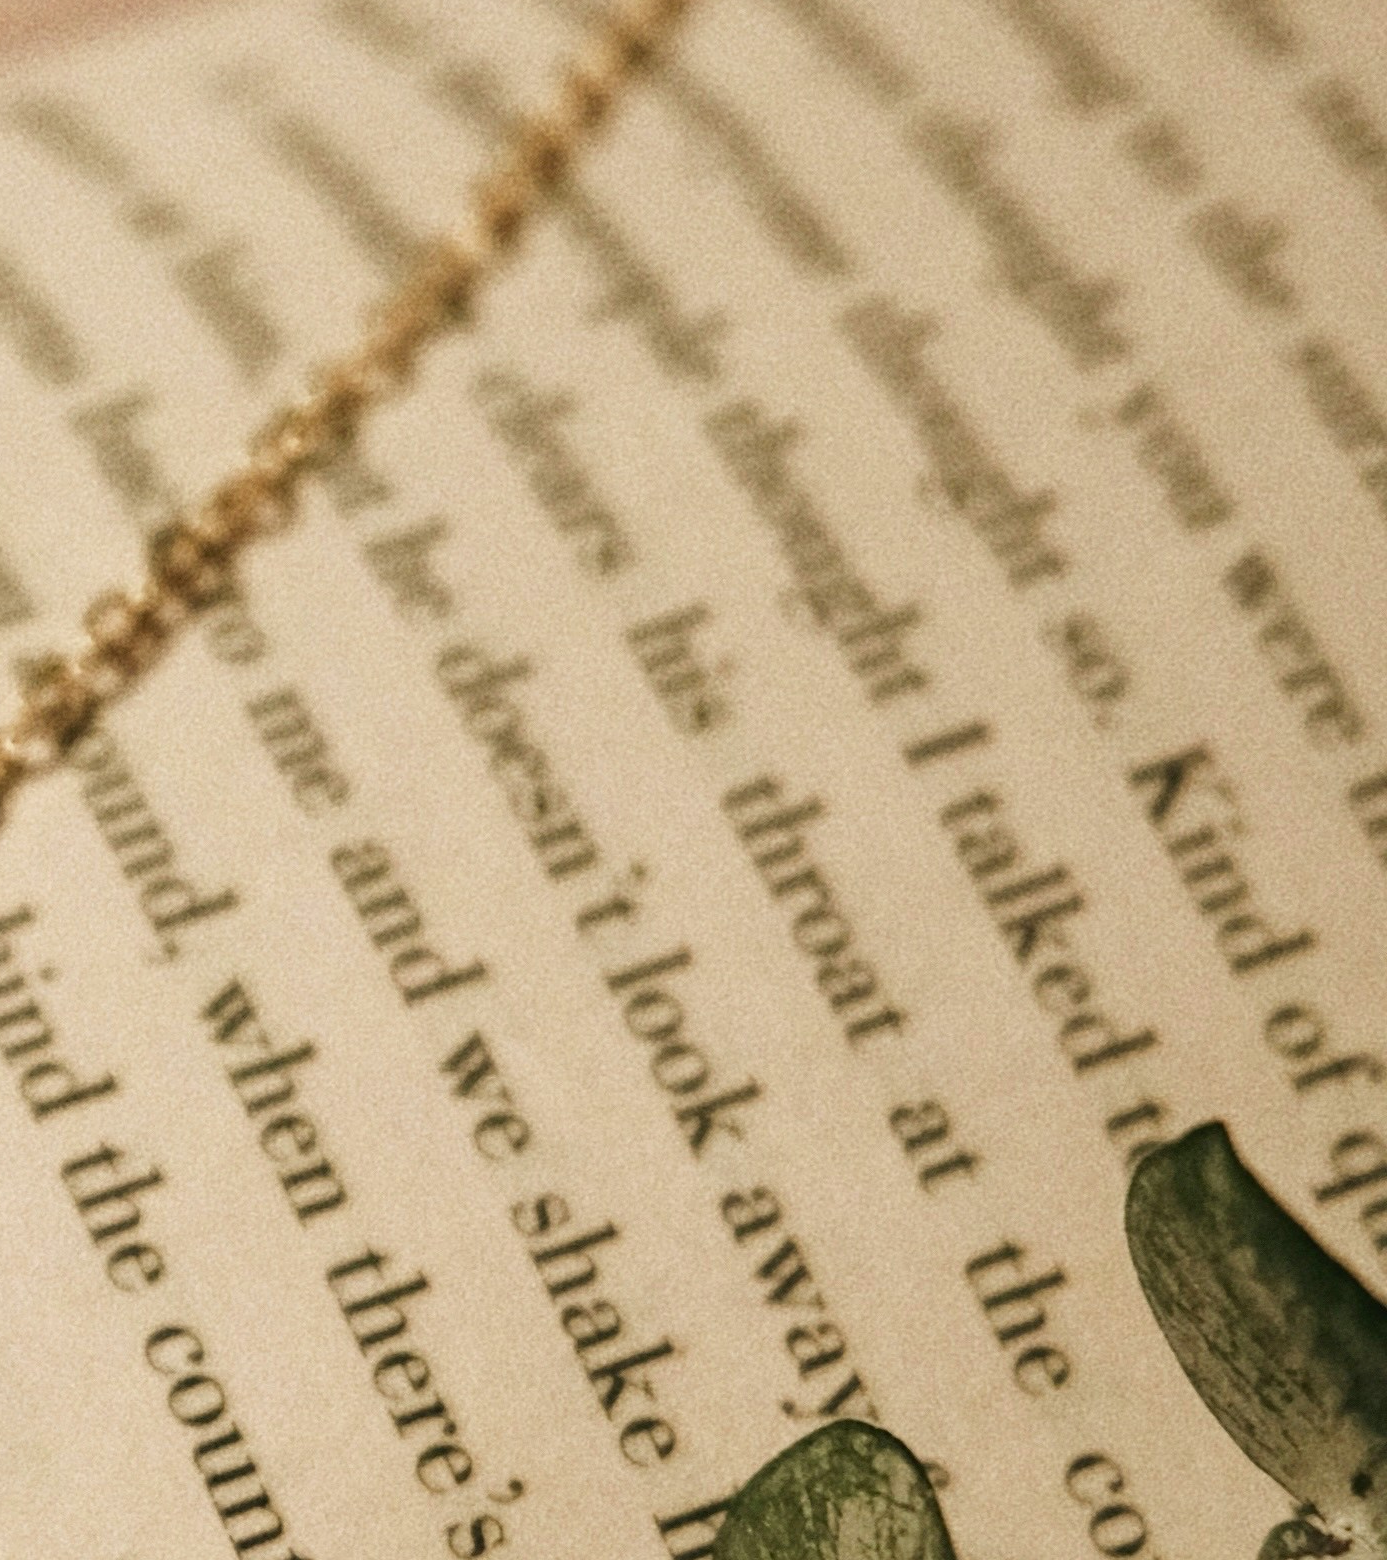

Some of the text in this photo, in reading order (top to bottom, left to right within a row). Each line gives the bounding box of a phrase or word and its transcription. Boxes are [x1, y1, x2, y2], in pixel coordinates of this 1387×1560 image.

[6, 645, 250, 970] ound,
[200, 978, 350, 1227] when
[903, 720, 992, 768] I
[940, 789, 1162, 1078] talked
[1127, 743, 1318, 977] Kind
[1263, 1002, 1387, 1096] of
[60, 1143, 167, 1287] the
[246, 687, 351, 807] me
[329, 839, 491, 1009] and
[439, 1030, 533, 1156] we
[512, 1194, 679, 1467] shake
[435, 643, 649, 937] doesn’t
[604, 946, 764, 1160] look
[713, 1180, 884, 1438] away
[624, 602, 733, 738] his
[721, 774, 910, 1051] throat
[887, 1099, 981, 1191] at
[964, 1240, 1073, 1391] the
